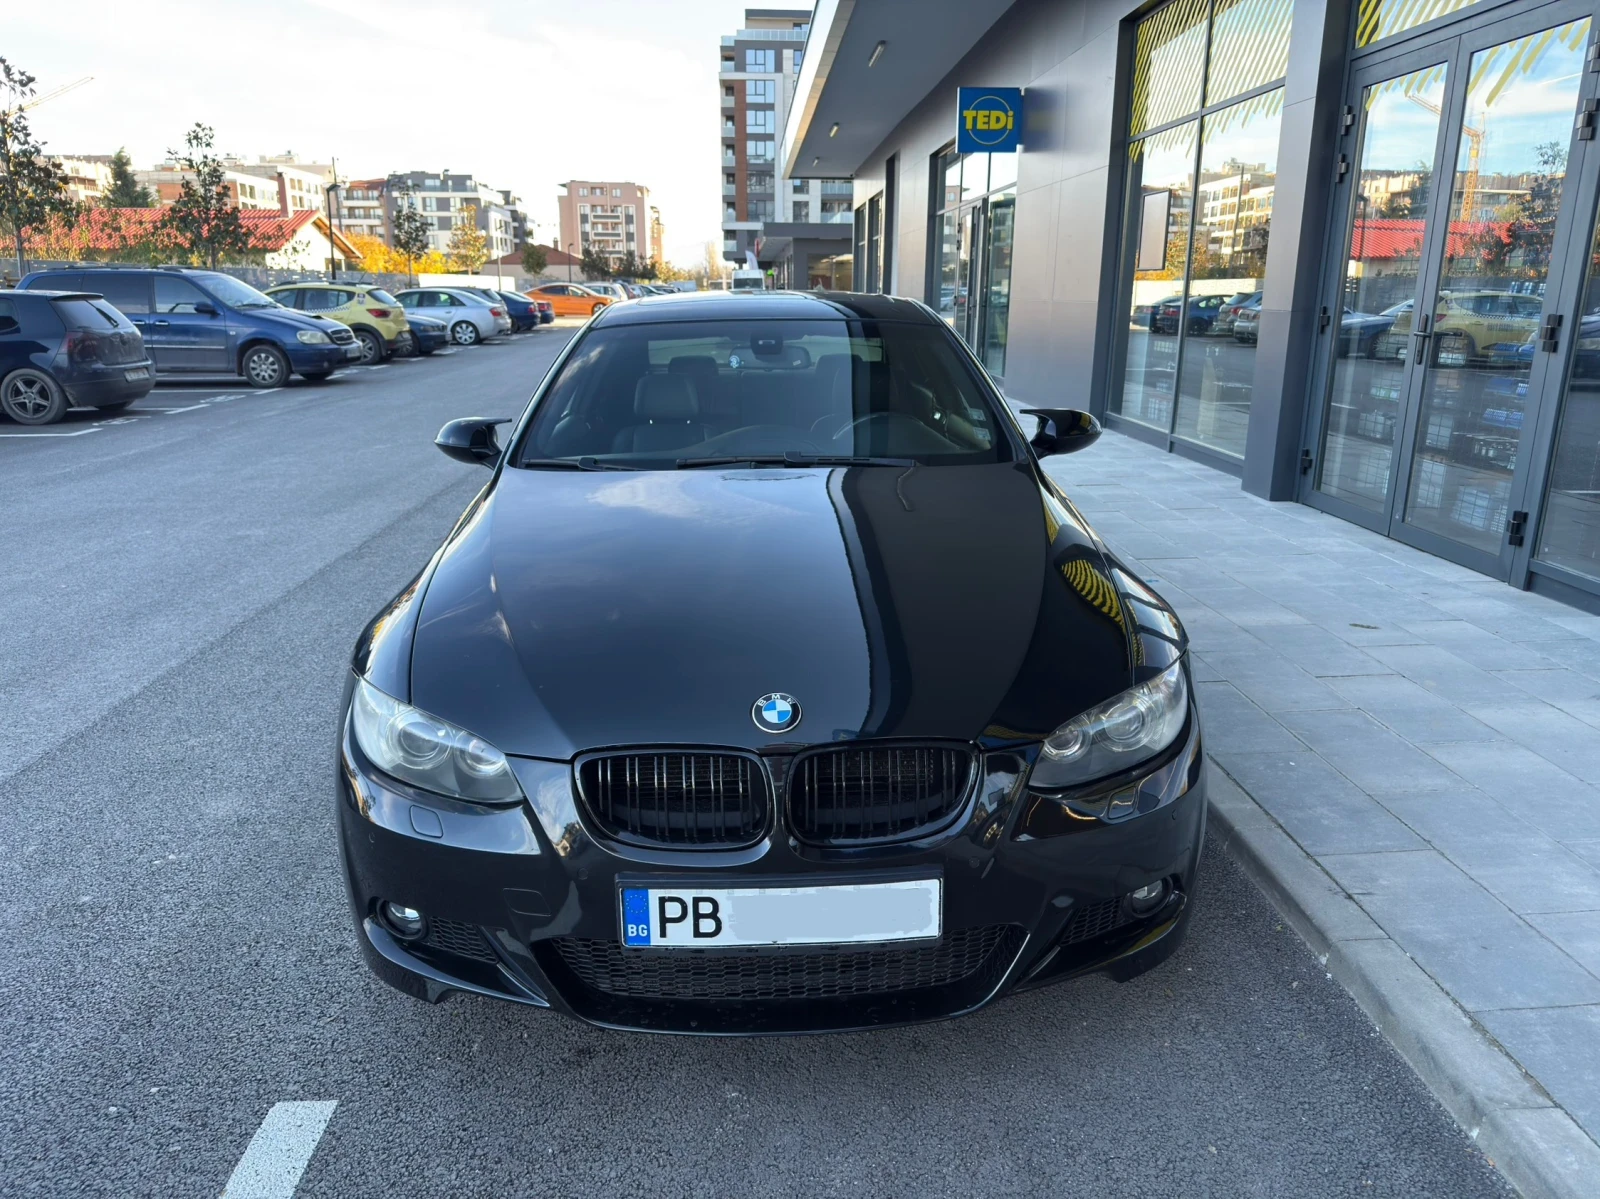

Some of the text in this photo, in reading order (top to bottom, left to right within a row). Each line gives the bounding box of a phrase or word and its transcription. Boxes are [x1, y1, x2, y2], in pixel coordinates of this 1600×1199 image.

[963, 110, 1014, 130] TEDi
[757, 694, 796, 706] BMW
[658, 896, 722, 938] PB
[627, 924, 648, 937] BG
